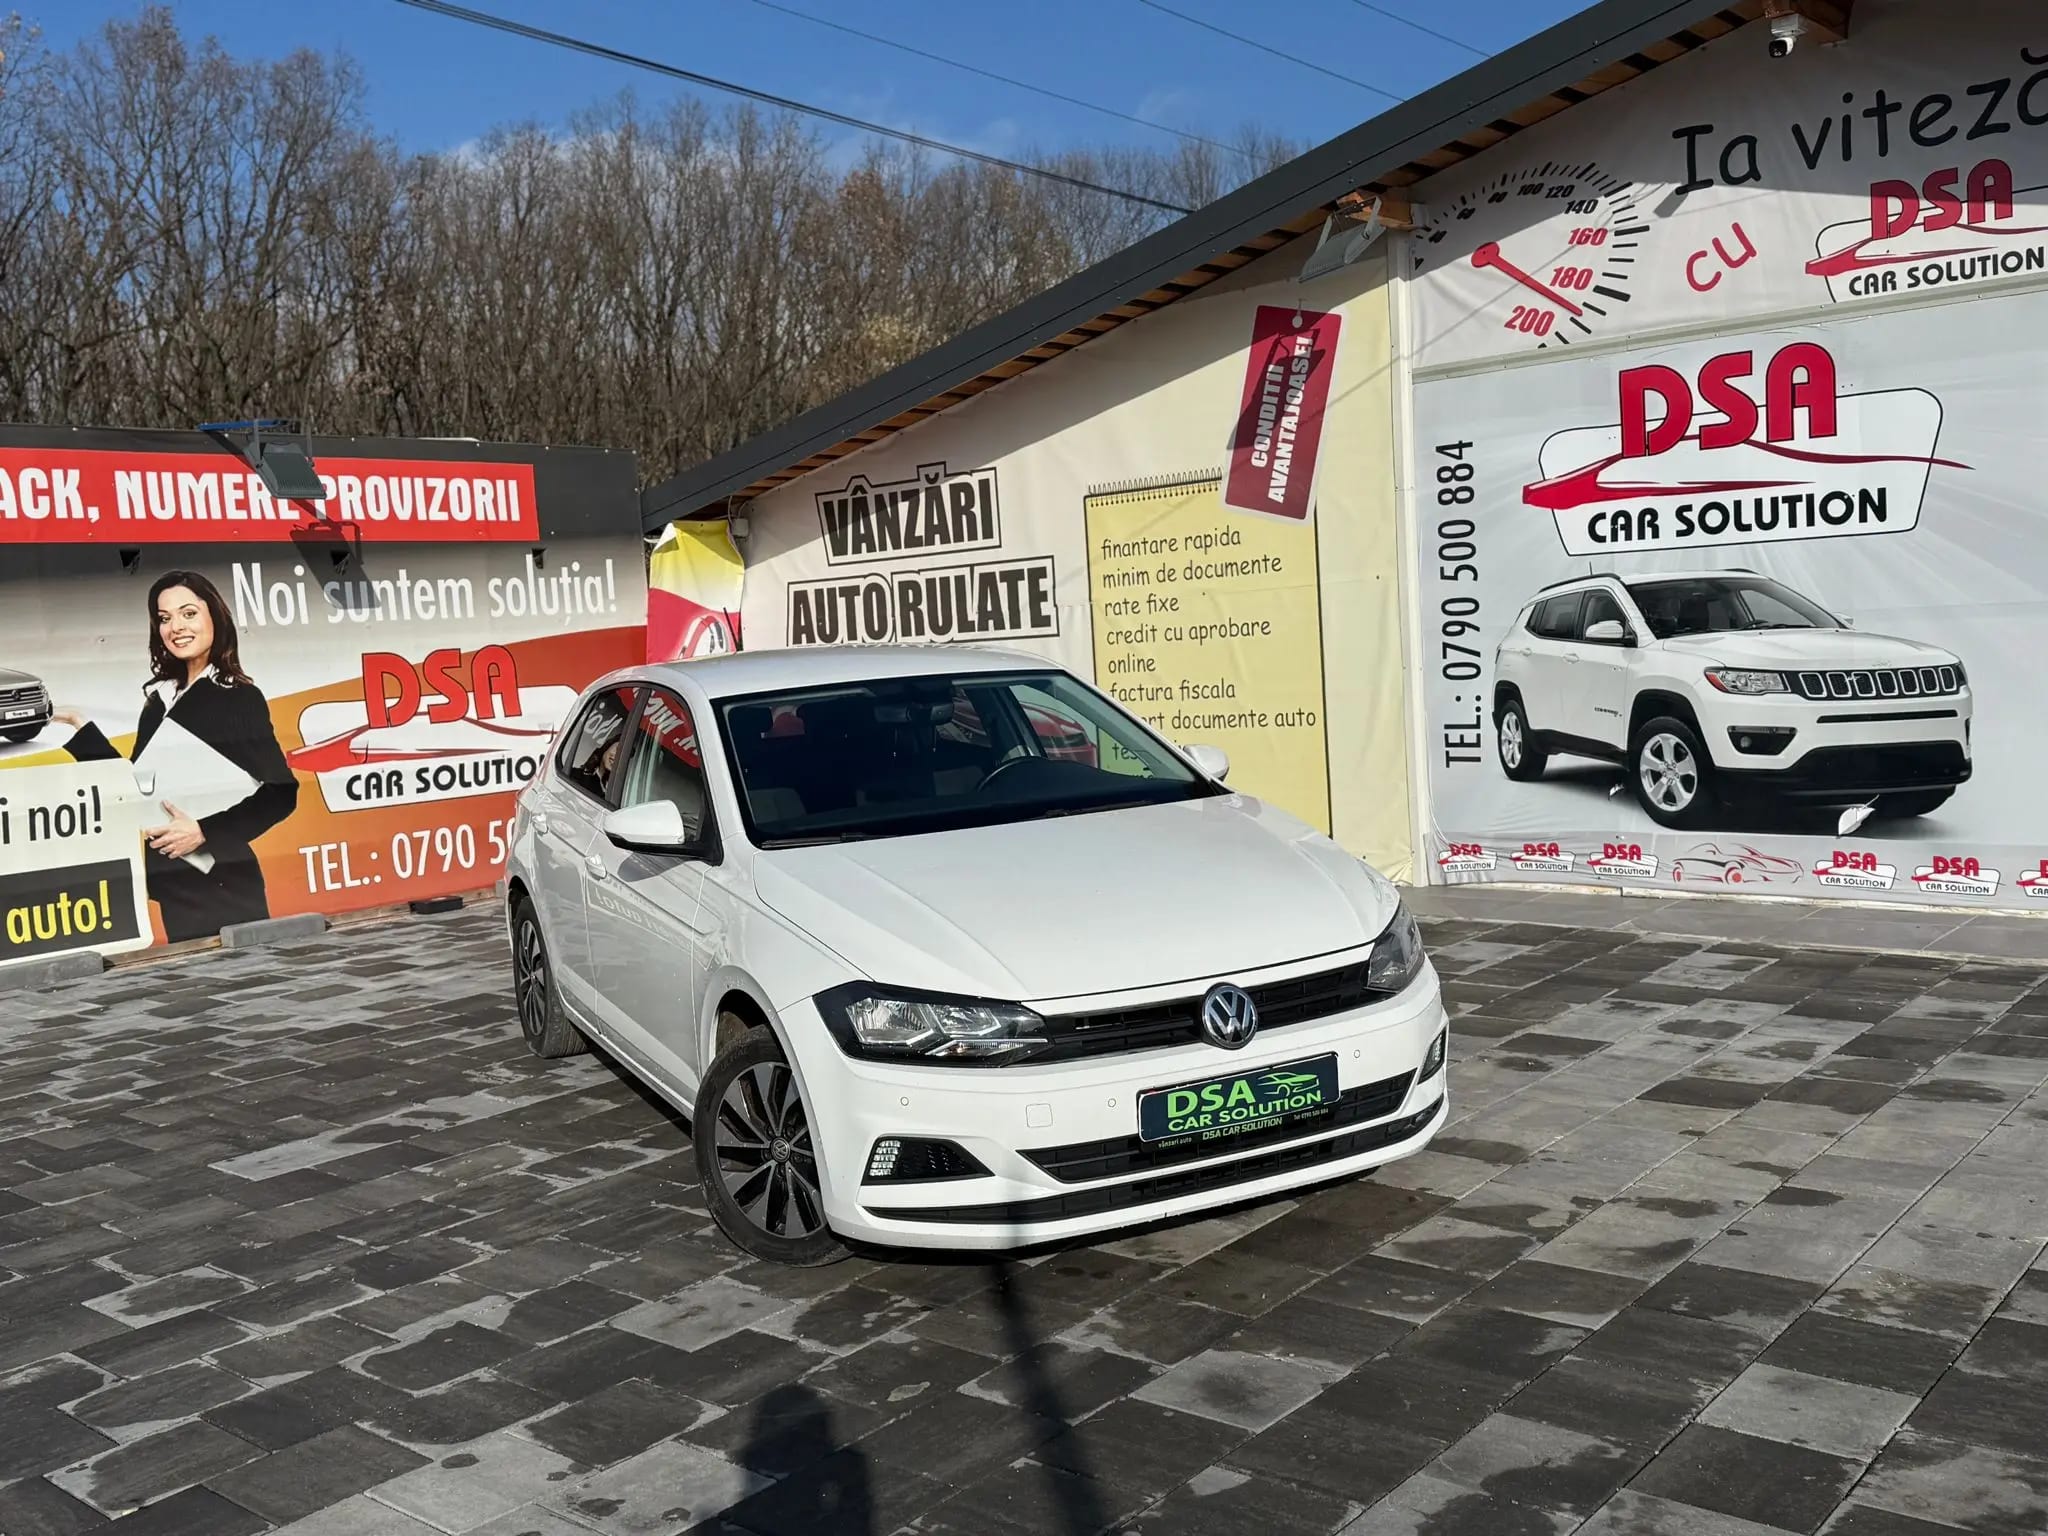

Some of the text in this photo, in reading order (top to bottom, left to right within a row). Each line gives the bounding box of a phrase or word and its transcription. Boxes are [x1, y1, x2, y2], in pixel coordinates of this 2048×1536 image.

[1671, 124, 1761, 196] Ia
[1517, 182, 1545, 196] 100
[1545, 184, 1575, 199] 120
[1869, 158, 2013, 241] DSA
[1564, 199, 1598, 215] 140
[1568, 227, 1608, 246] 160
[1685, 222, 1758, 292] cu
[1848, 245, 2046, 296] CAR SOLUTION
[1549, 266, 1593, 290] 180
[1504, 305, 1555, 337] 200
[1618, 341, 1837, 458] DSA
[1268, 336, 1313, 504] AVANTAJOASE!
[822, 471, 994, 556] VÂNZĂRI
[1587, 487, 1888, 543] CAR SOLUTION
[1101, 525, 1241, 560] finantare rapida
[1102, 554, 1282, 589] minim de documente
[231, 563, 309, 627] Noi
[323, 569, 474, 624] suntem
[792, 566, 1051, 645] AUTO RULATE
[1104, 593, 1180, 616] rate fixe
[1435, 440, 1482, 768] TEL.: 0790 500 884
[1106, 617, 1272, 646] credit cu aprobare
[1108, 653, 1156, 674] online
[362, 644, 522, 729] DSA
[1109, 678, 1236, 702] factura fiscala
[1172, 709, 1269, 730] documente
[1274, 708, 1316, 727] auto
[345, 770, 404, 801] CAR
[28, 785, 103, 841] noi!
[298, 841, 382, 893] TEL.:
[391, 824, 476, 880] 0790
[1449, 843, 1483, 856] DSA
[1523, 842, 1560, 857] DSA
[1603, 842, 1642, 860] DSA
[1832, 851, 1877, 871] DSA
[1446, 863, 1459, 871] CAR
[1520, 862, 1568, 871] CAR SOLUTION
[1615, 868, 1650, 876] SOLUTION
[1933, 856, 1980, 876] DSA
[1825, 876, 1886, 888] CAR SOLUTION
[1926, 883, 1989, 894] CAR SOLUTION
[6, 879, 112, 944] auto!
[1166, 1079, 1256, 1119] DSA
[1167, 1114, 1213, 1132] CAR
[1219, 1090, 1322, 1122] SOLUTION
[1202, 1117, 1283, 1141] DSA CAR SOLUTION
